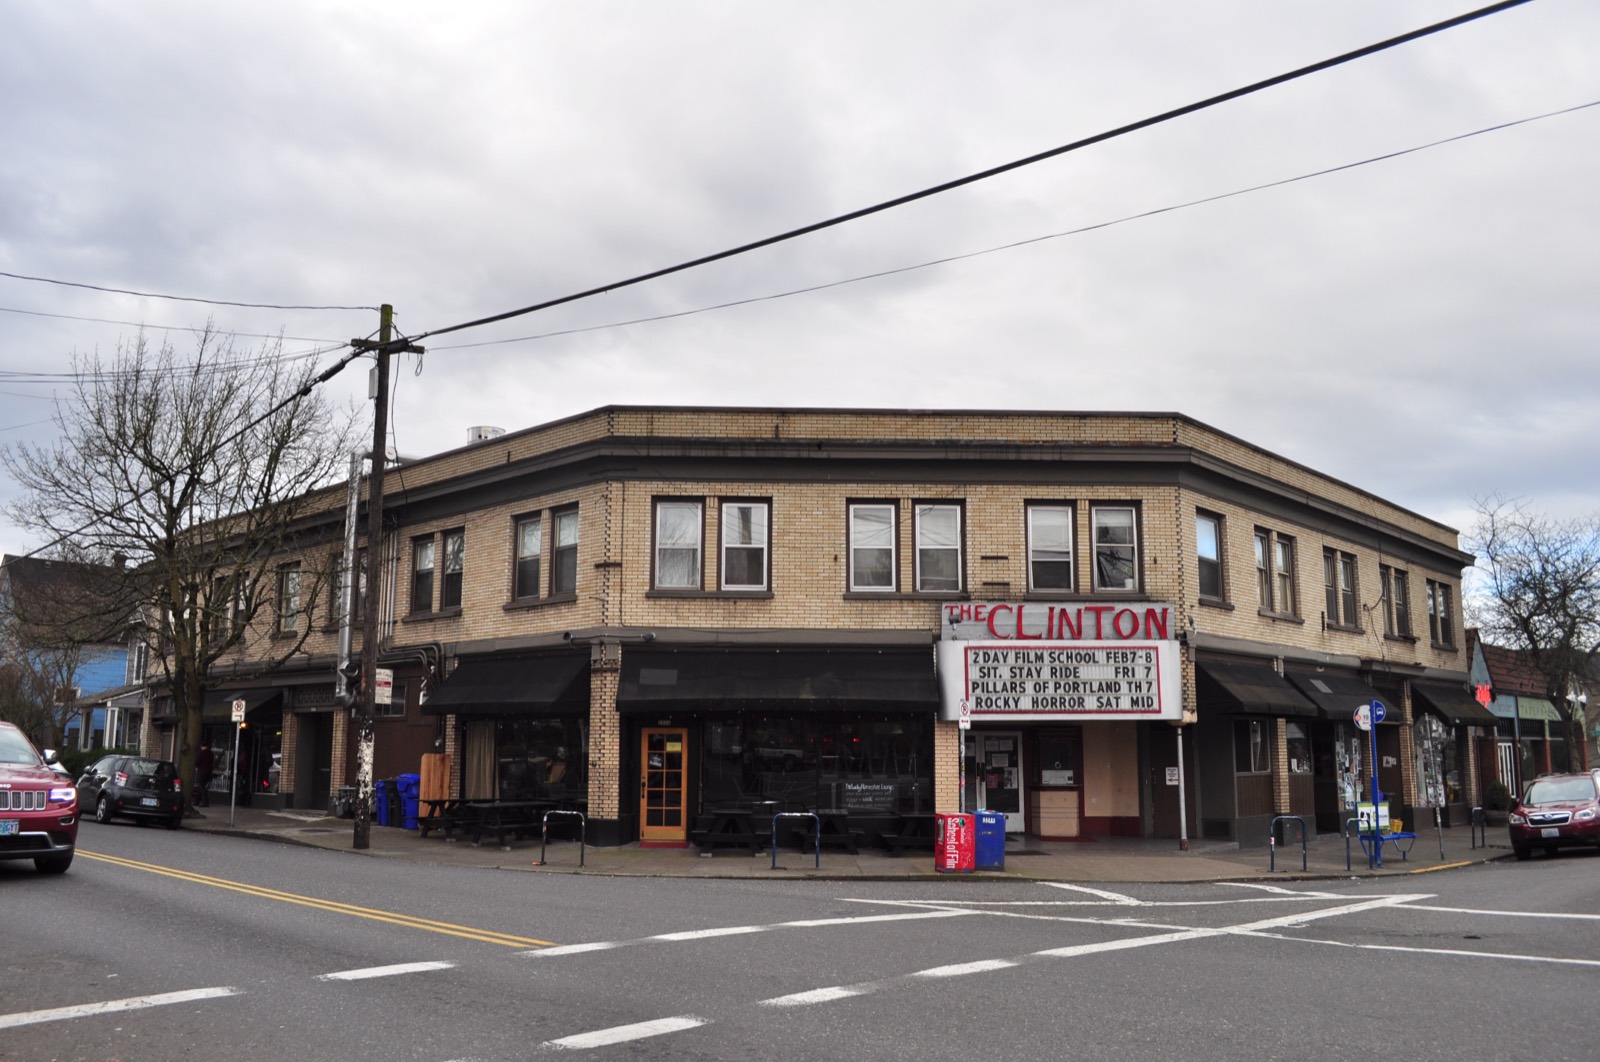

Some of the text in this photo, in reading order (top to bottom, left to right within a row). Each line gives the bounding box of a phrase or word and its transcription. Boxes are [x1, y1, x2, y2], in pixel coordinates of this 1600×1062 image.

[944, 604, 1168, 640] THE CLINTON
[972, 651, 980, 664] 2
[982, 651, 1009, 664] DAY
[1014, 651, 1045, 664] FILM
[1048, 650, 1100, 664] SCHOOL
[978, 666, 1152, 680] SIT. STAY RIDE FRI 7
[971, 681, 1027, 694] PILLARS
[1033, 681, 1050, 694] OF
[1053, 681, 1122, 694] PORTLAND
[975, 695, 1154, 710] ROCKY HORROR SAT MID
[946, 817, 960, 845] School
[946, 844, 960, 854] of
